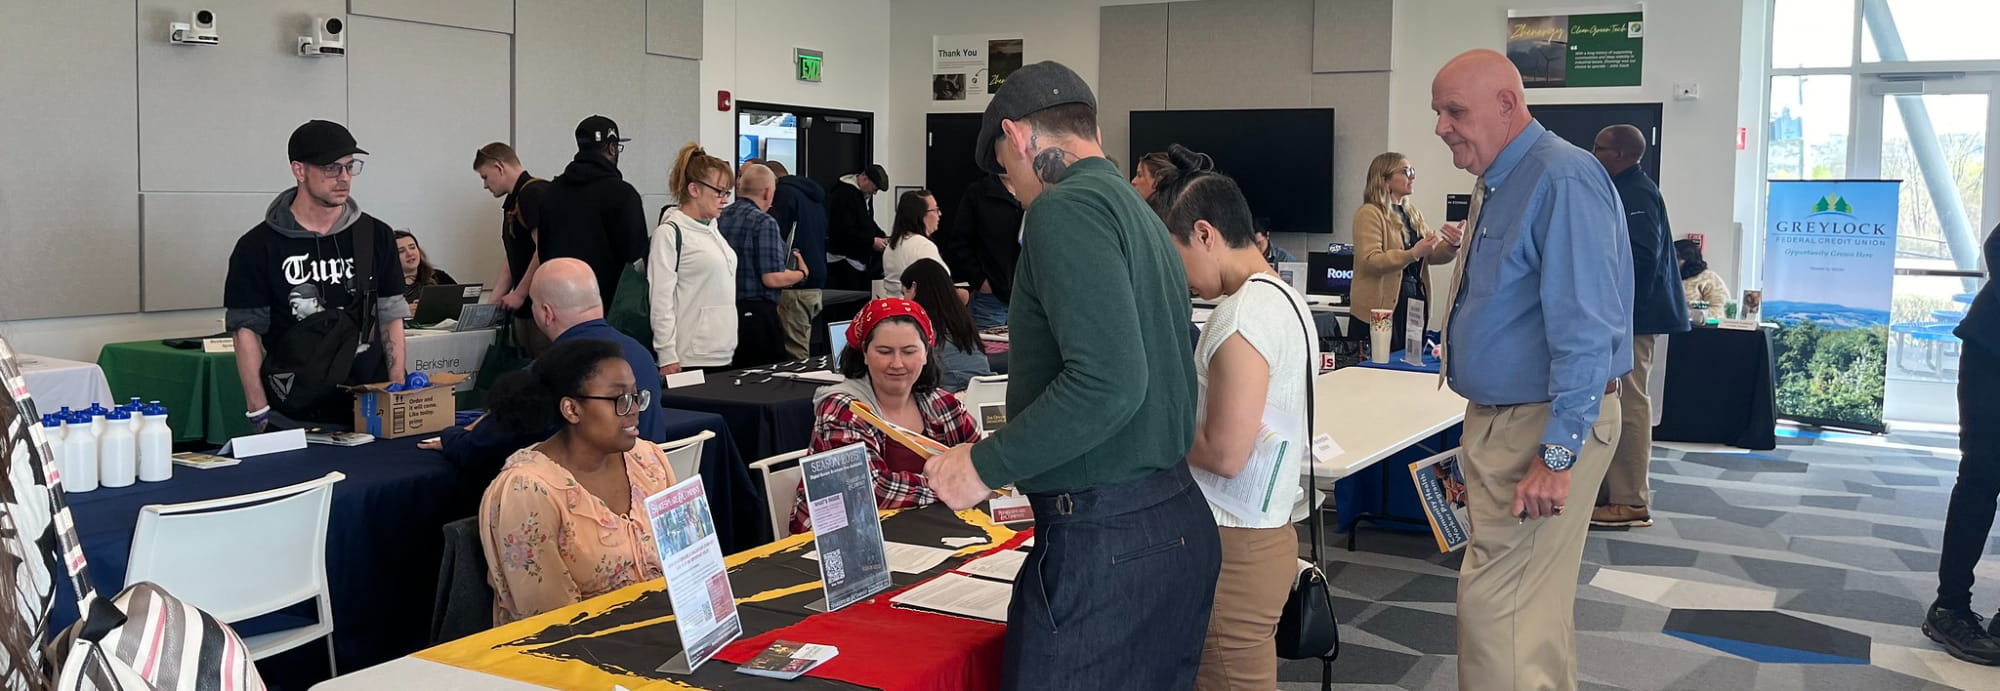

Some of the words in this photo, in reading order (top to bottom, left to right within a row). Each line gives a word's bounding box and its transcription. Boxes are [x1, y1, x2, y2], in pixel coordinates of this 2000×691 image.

[938, 48, 961, 57] Thank
[962, 48, 978, 57] You
[1776, 221, 1887, 235] GREYLOCK
[1775, 236, 1816, 245] FEDERAL
[1817, 237, 1853, 246] CREDIT
[1855, 238, 1887, 246] UNION
[1784, 248, 1829, 257] Opportunity
[282, 253, 355, 285] Tupa
[415, 358, 460, 371] Berkshire
[811, 456, 840, 473] SEASON
[1420, 473, 1433, 500] Health
[1430, 479, 1448, 512] Program
[1431, 501, 1455, 544] Community
[1446, 513, 1462, 542] Worker
